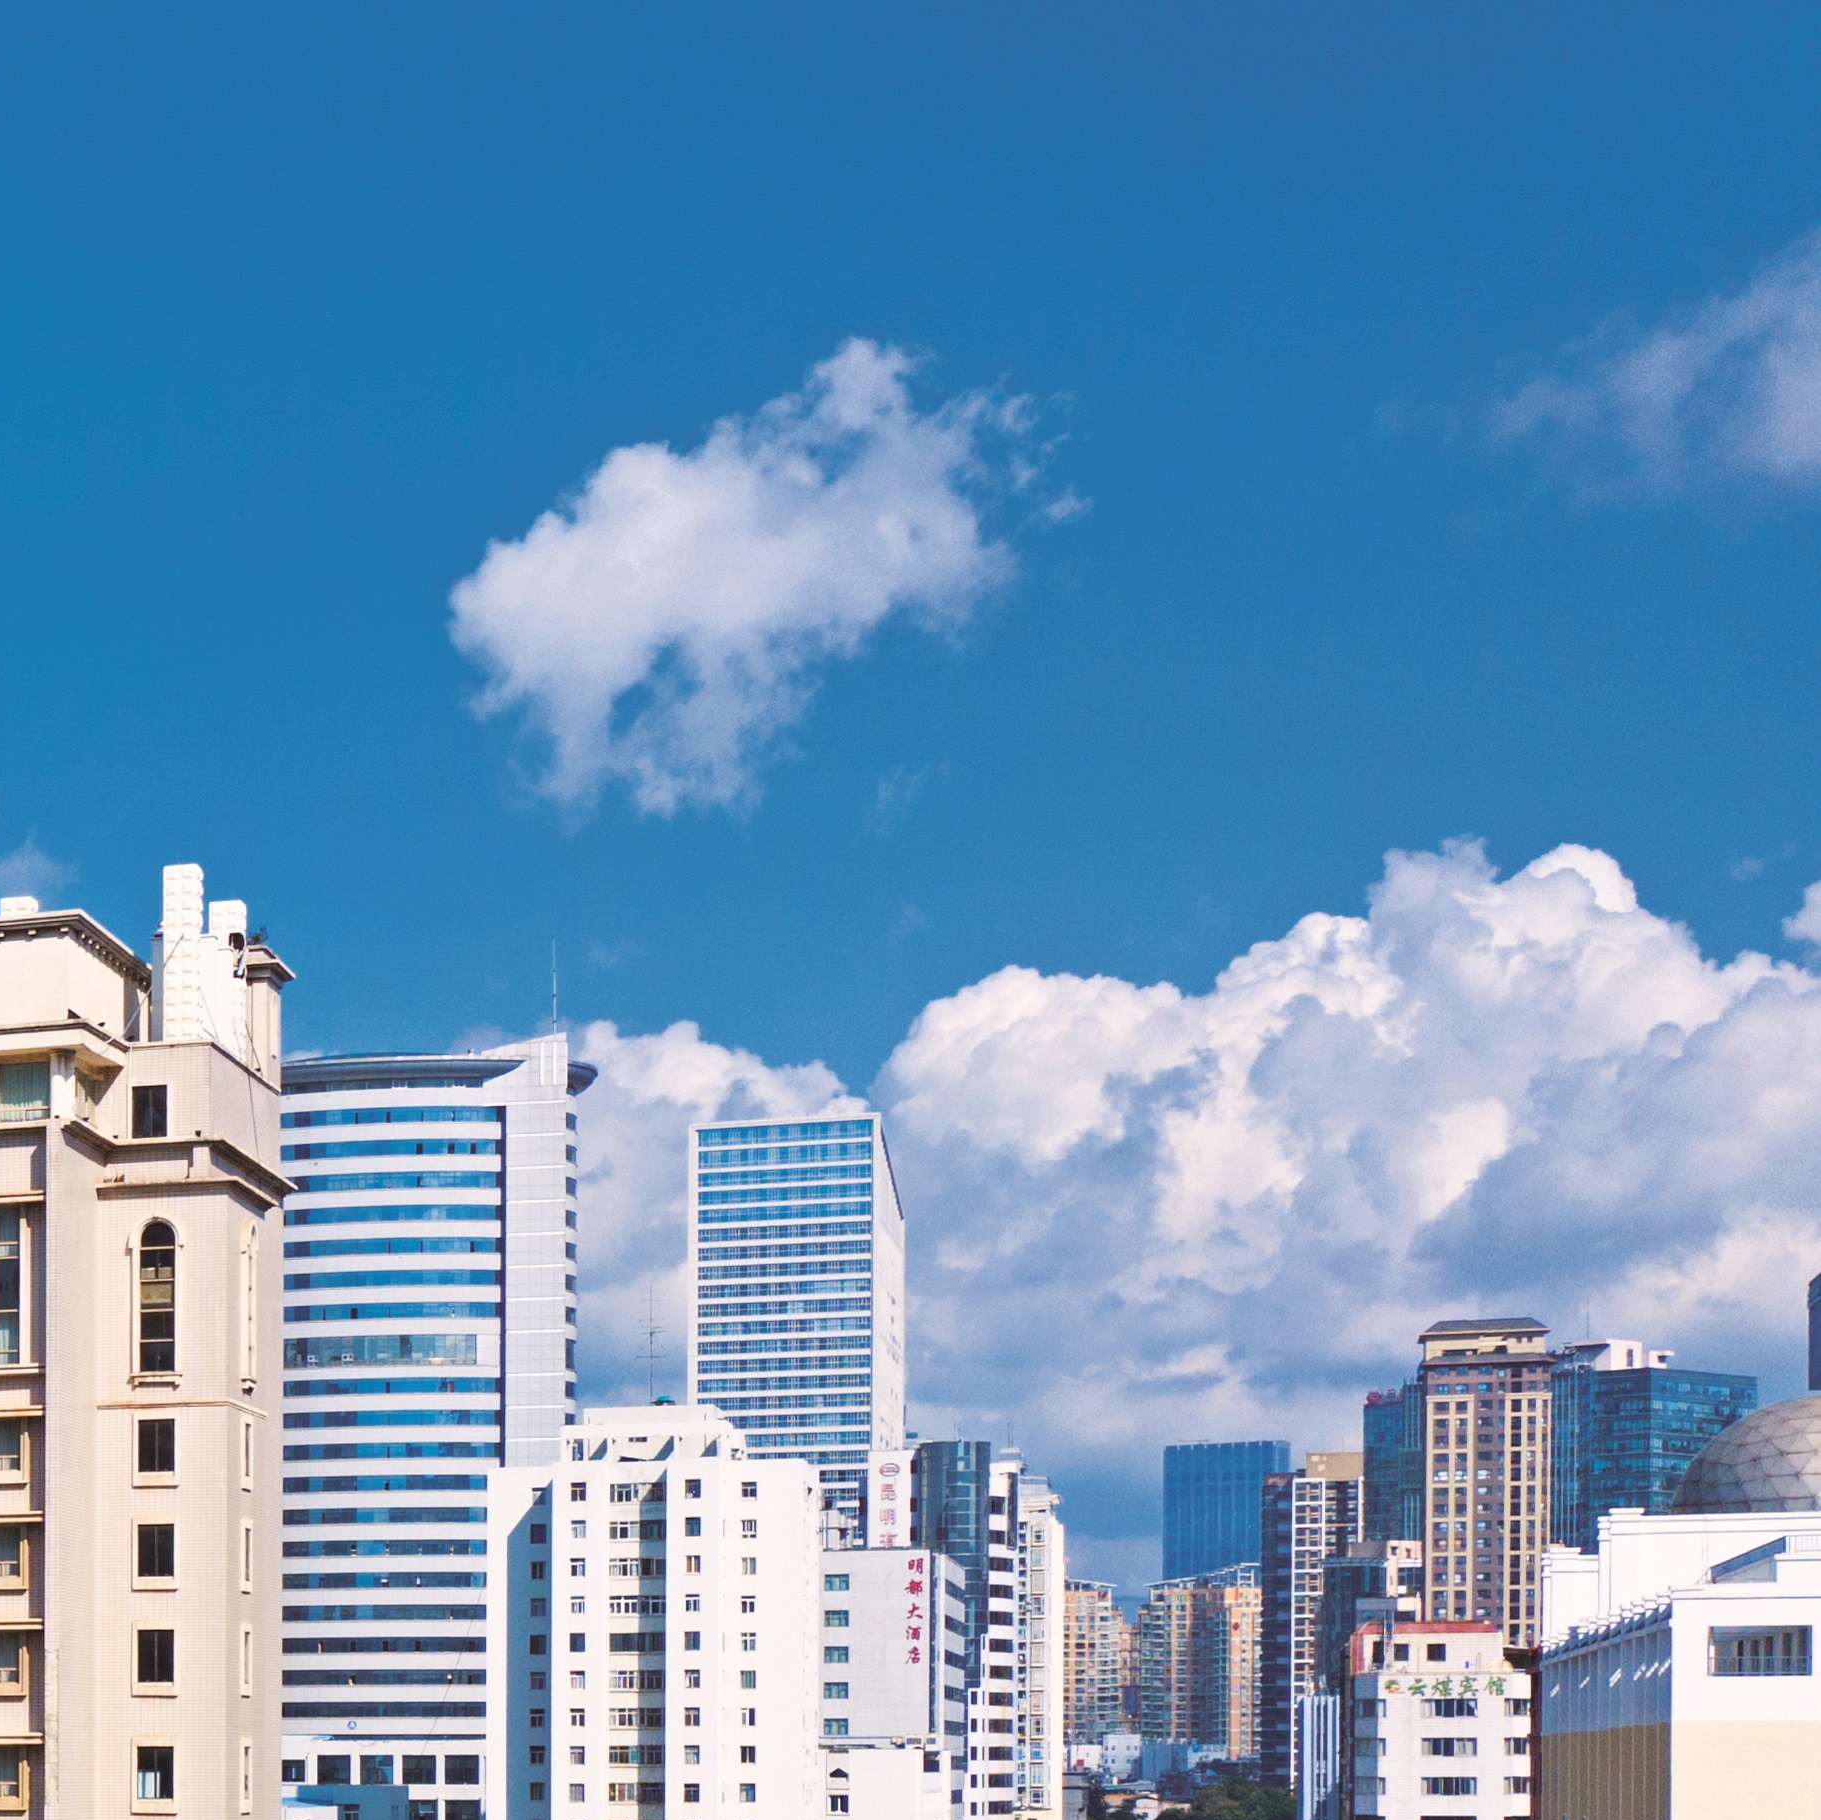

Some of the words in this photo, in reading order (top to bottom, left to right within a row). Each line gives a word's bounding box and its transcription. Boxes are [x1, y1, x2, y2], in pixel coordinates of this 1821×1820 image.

[905, 1557, 923, 1665] 明都大酒店
[1408, 1676, 1507, 1698] 云煤宾馆
